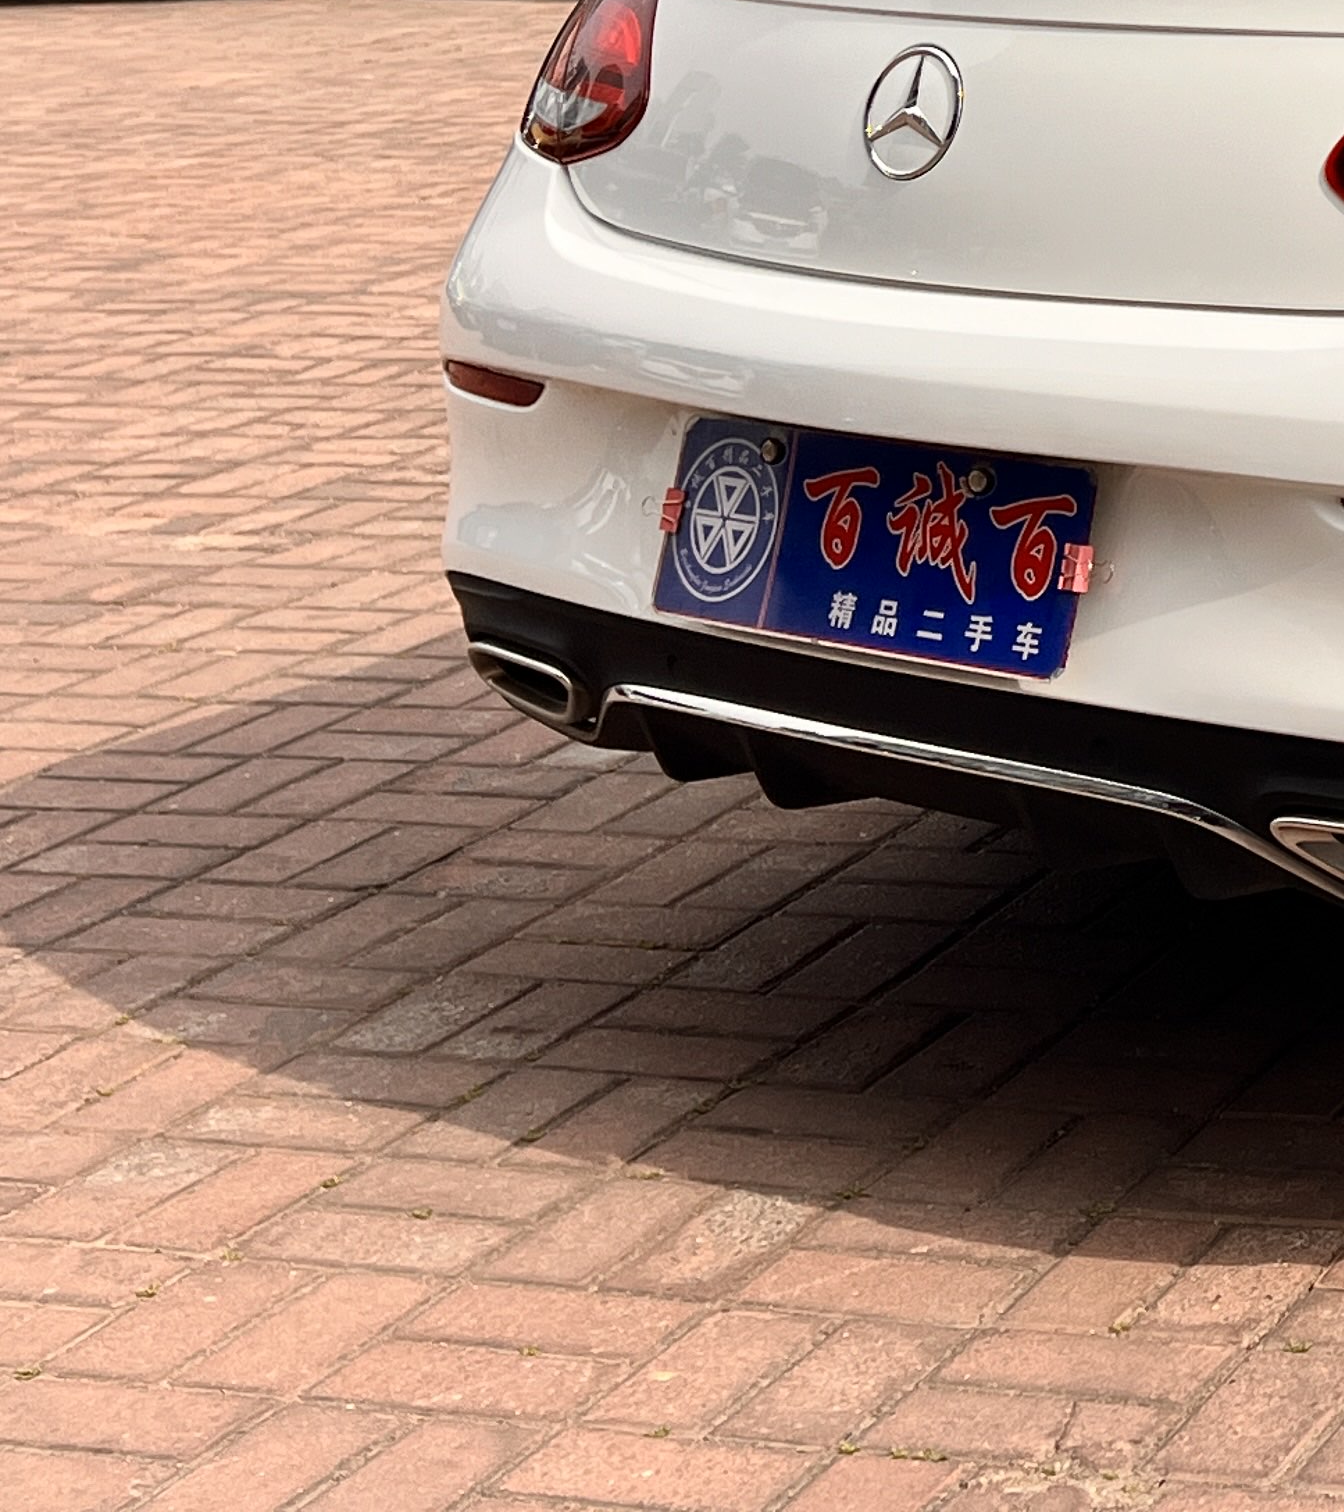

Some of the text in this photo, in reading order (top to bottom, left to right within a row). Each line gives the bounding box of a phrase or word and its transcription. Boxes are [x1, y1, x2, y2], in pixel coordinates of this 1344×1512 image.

[828, 590, 1044, 661] 精品二手车
